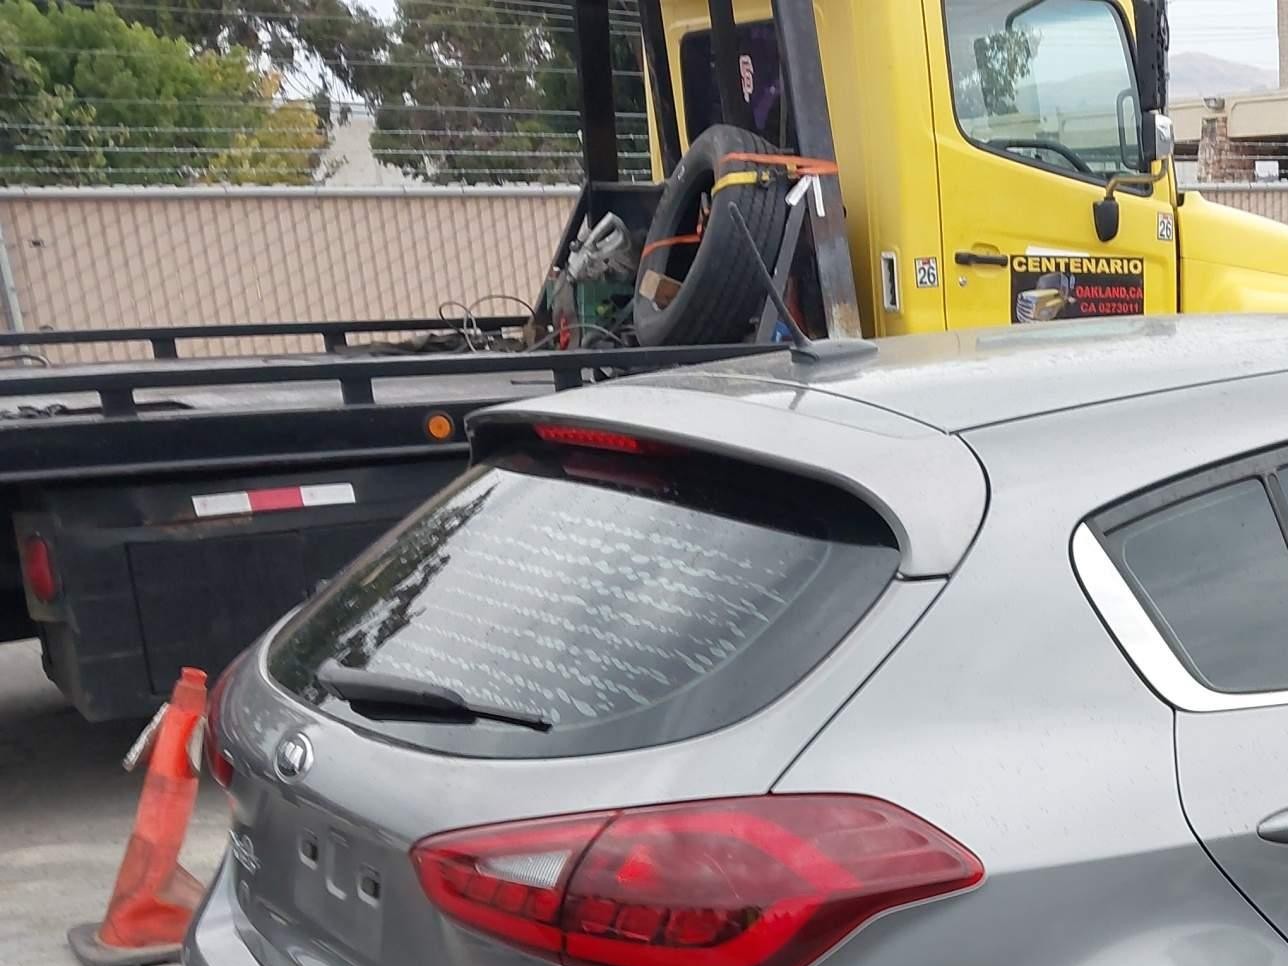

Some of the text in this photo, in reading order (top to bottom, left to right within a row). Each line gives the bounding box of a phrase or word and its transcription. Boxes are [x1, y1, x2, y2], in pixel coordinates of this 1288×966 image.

[1160, 220, 1172, 238] 26
[1012, 256, 1143, 274] CENTENARIO
[918, 266, 936, 284] 26
[1081, 303, 1096, 313] CA
